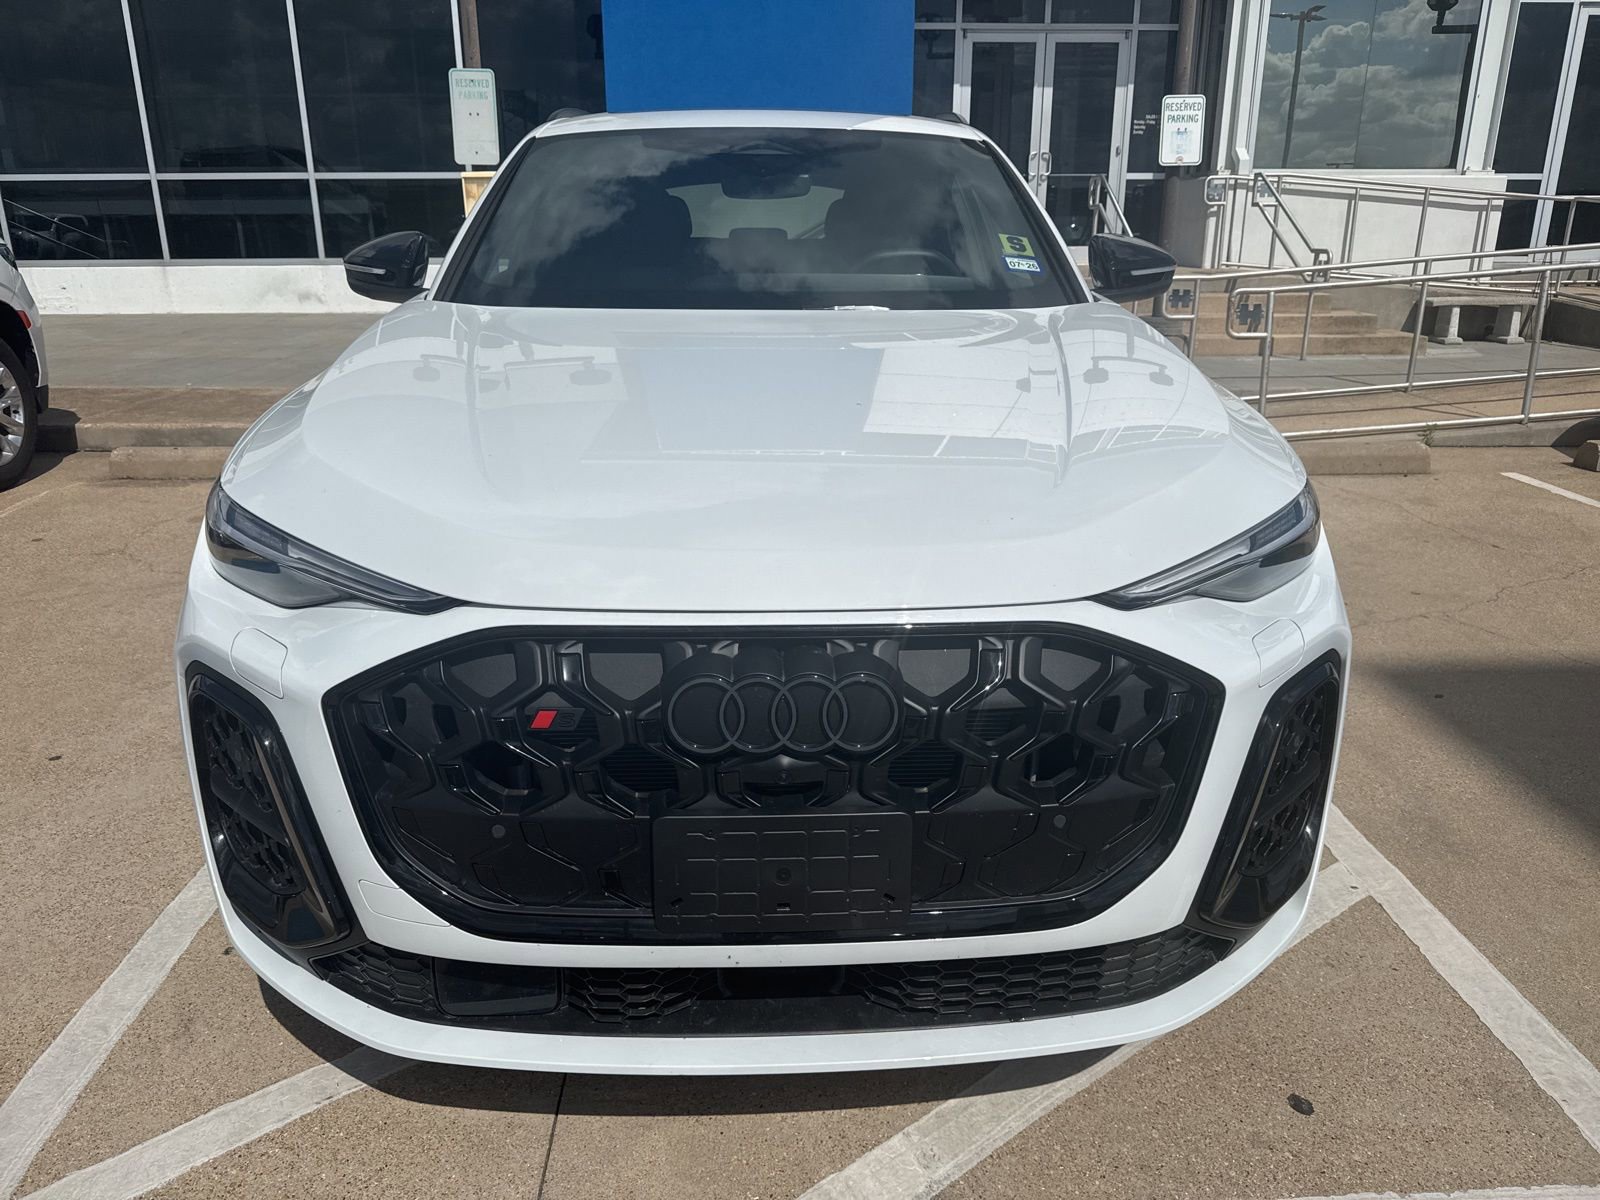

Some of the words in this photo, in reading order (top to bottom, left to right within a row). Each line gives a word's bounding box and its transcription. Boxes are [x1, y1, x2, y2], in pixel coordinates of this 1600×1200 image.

[1165, 102, 1203, 112] RESERVED
[1167, 114, 1199, 124] PARKING
[1006, 236, 1028, 253] S
